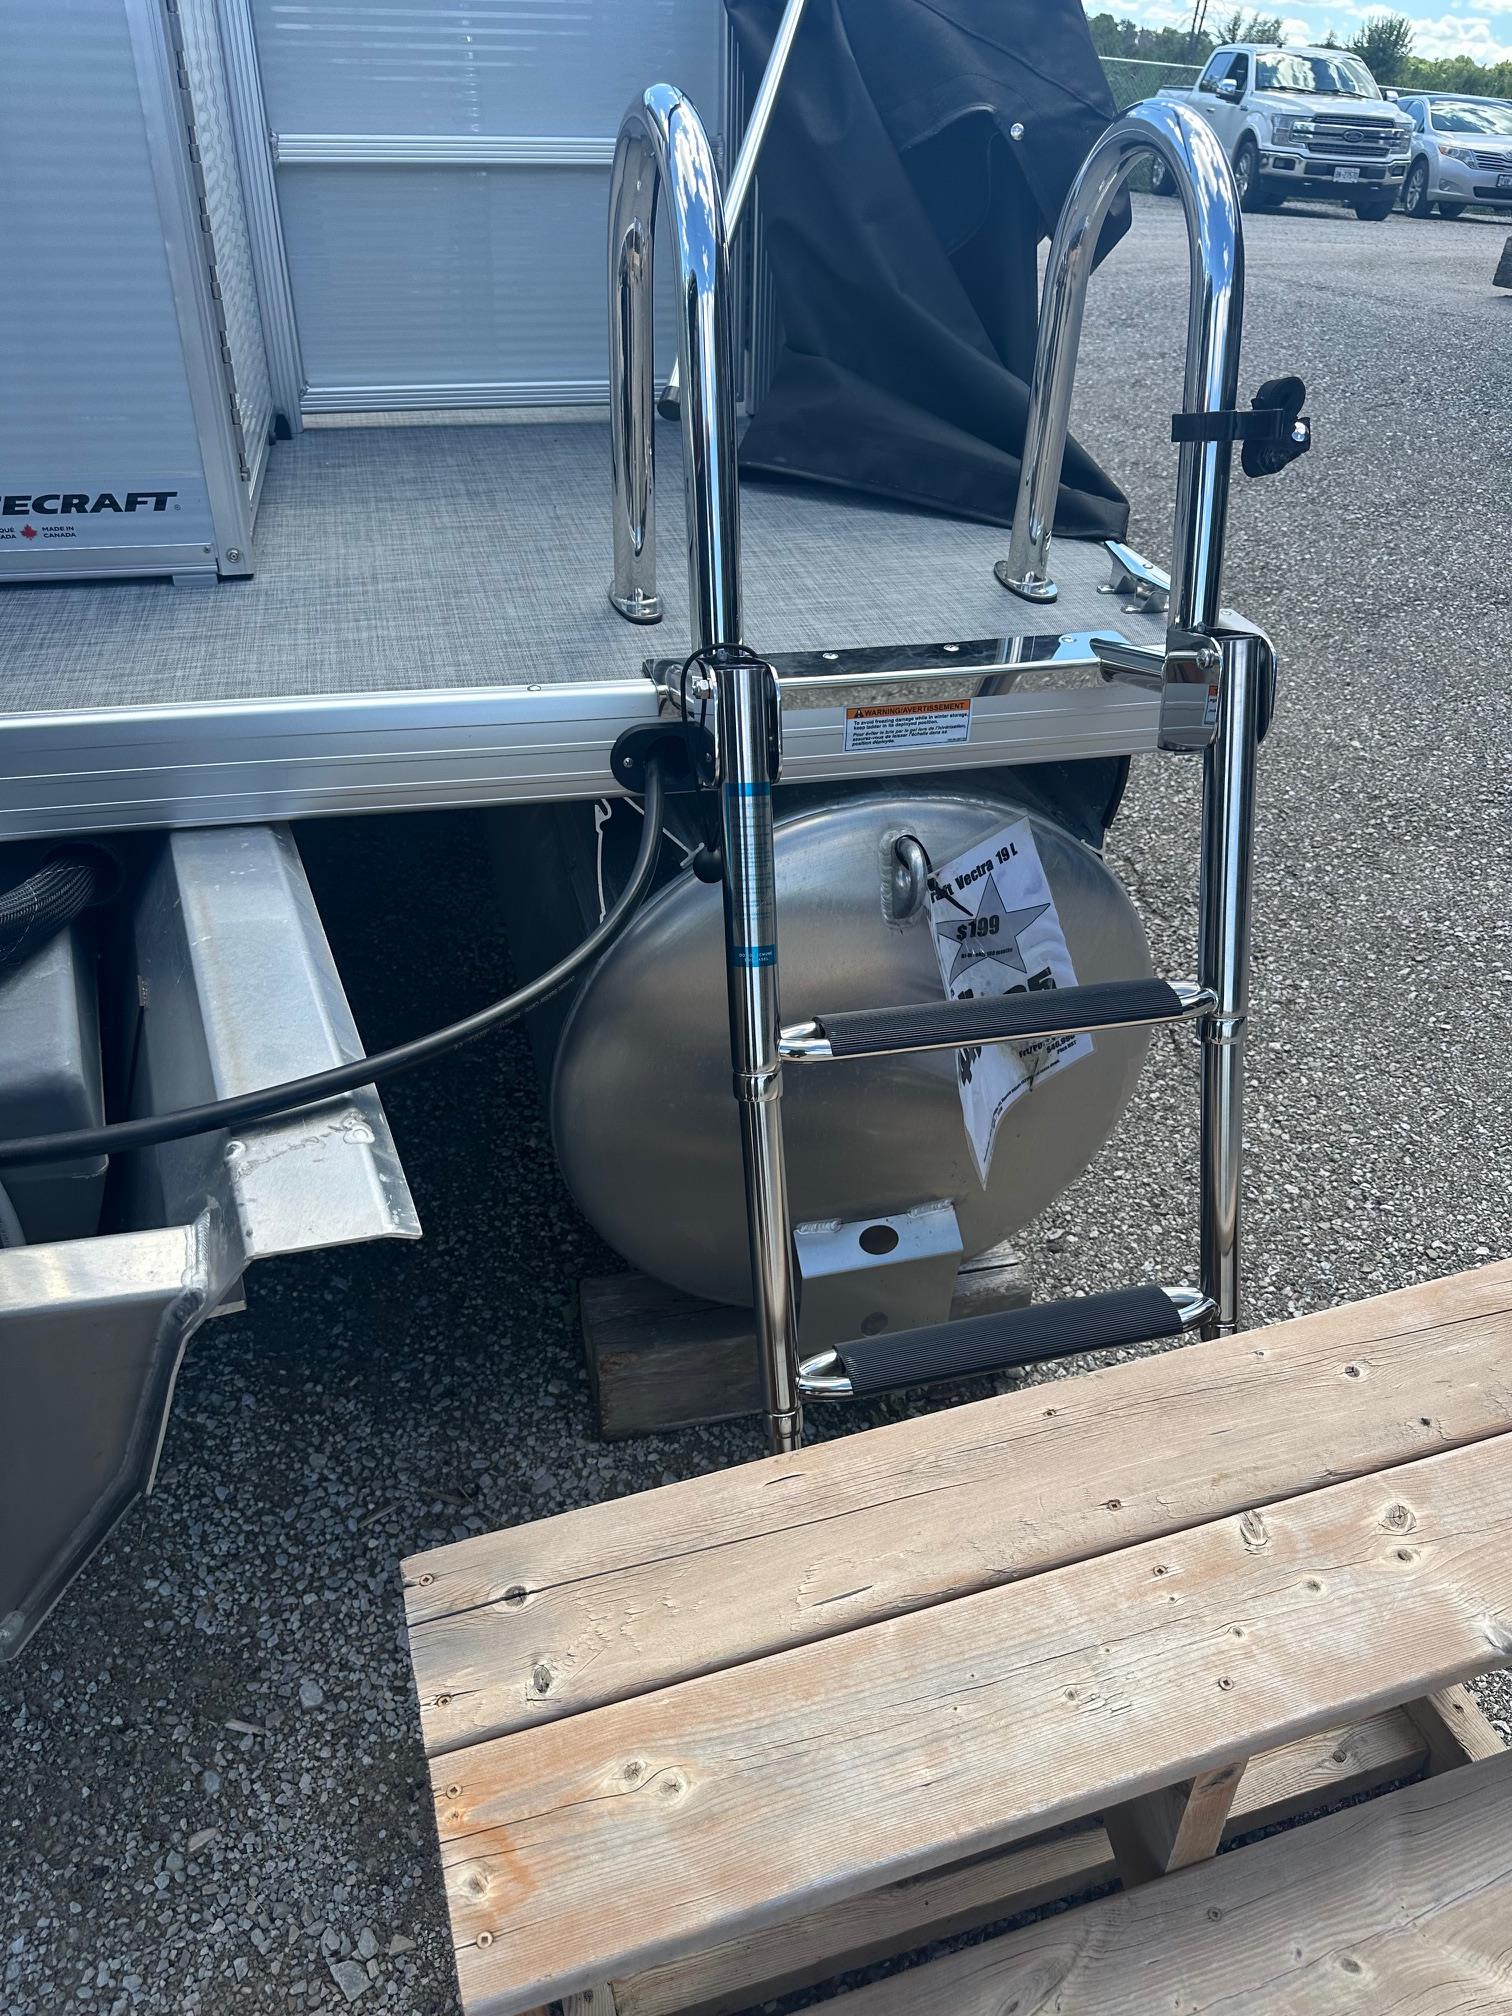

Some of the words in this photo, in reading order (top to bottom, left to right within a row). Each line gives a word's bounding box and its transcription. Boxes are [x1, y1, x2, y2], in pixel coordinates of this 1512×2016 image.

[0, 491, 178, 516] ECRAFT
[955, 859, 994, 891] Vectra
[995, 846, 1011, 865] 19
[1009, 842, 1019, 857] L
[956, 914, 1000, 942] $199
